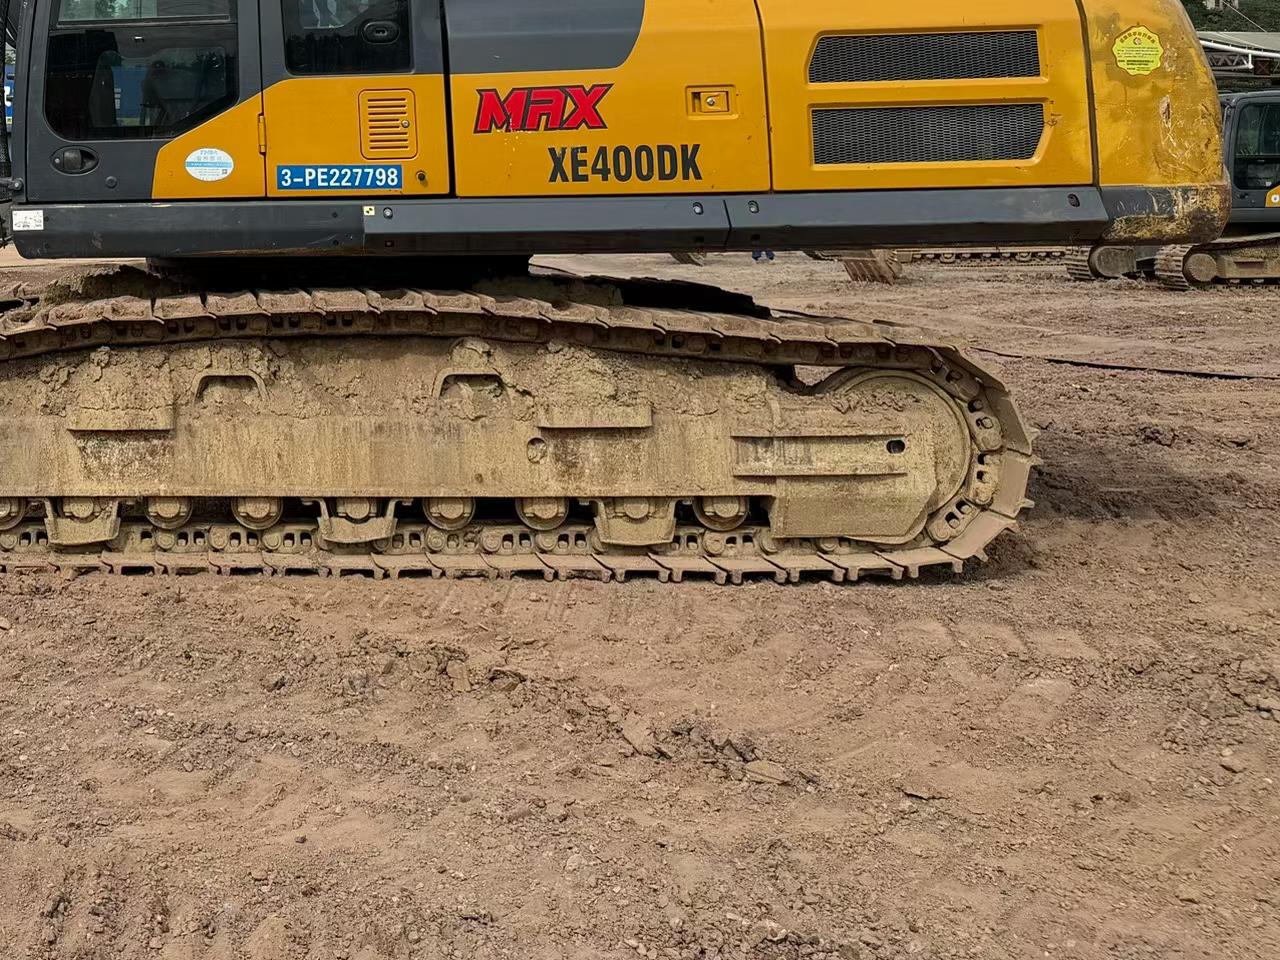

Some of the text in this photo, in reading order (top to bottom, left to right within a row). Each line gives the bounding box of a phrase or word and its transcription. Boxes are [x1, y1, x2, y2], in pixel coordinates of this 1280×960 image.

[473, 83, 614, 134] MAX
[281, 168, 398, 187] 3-PE227798
[547, 143, 703, 183] XE400DK
